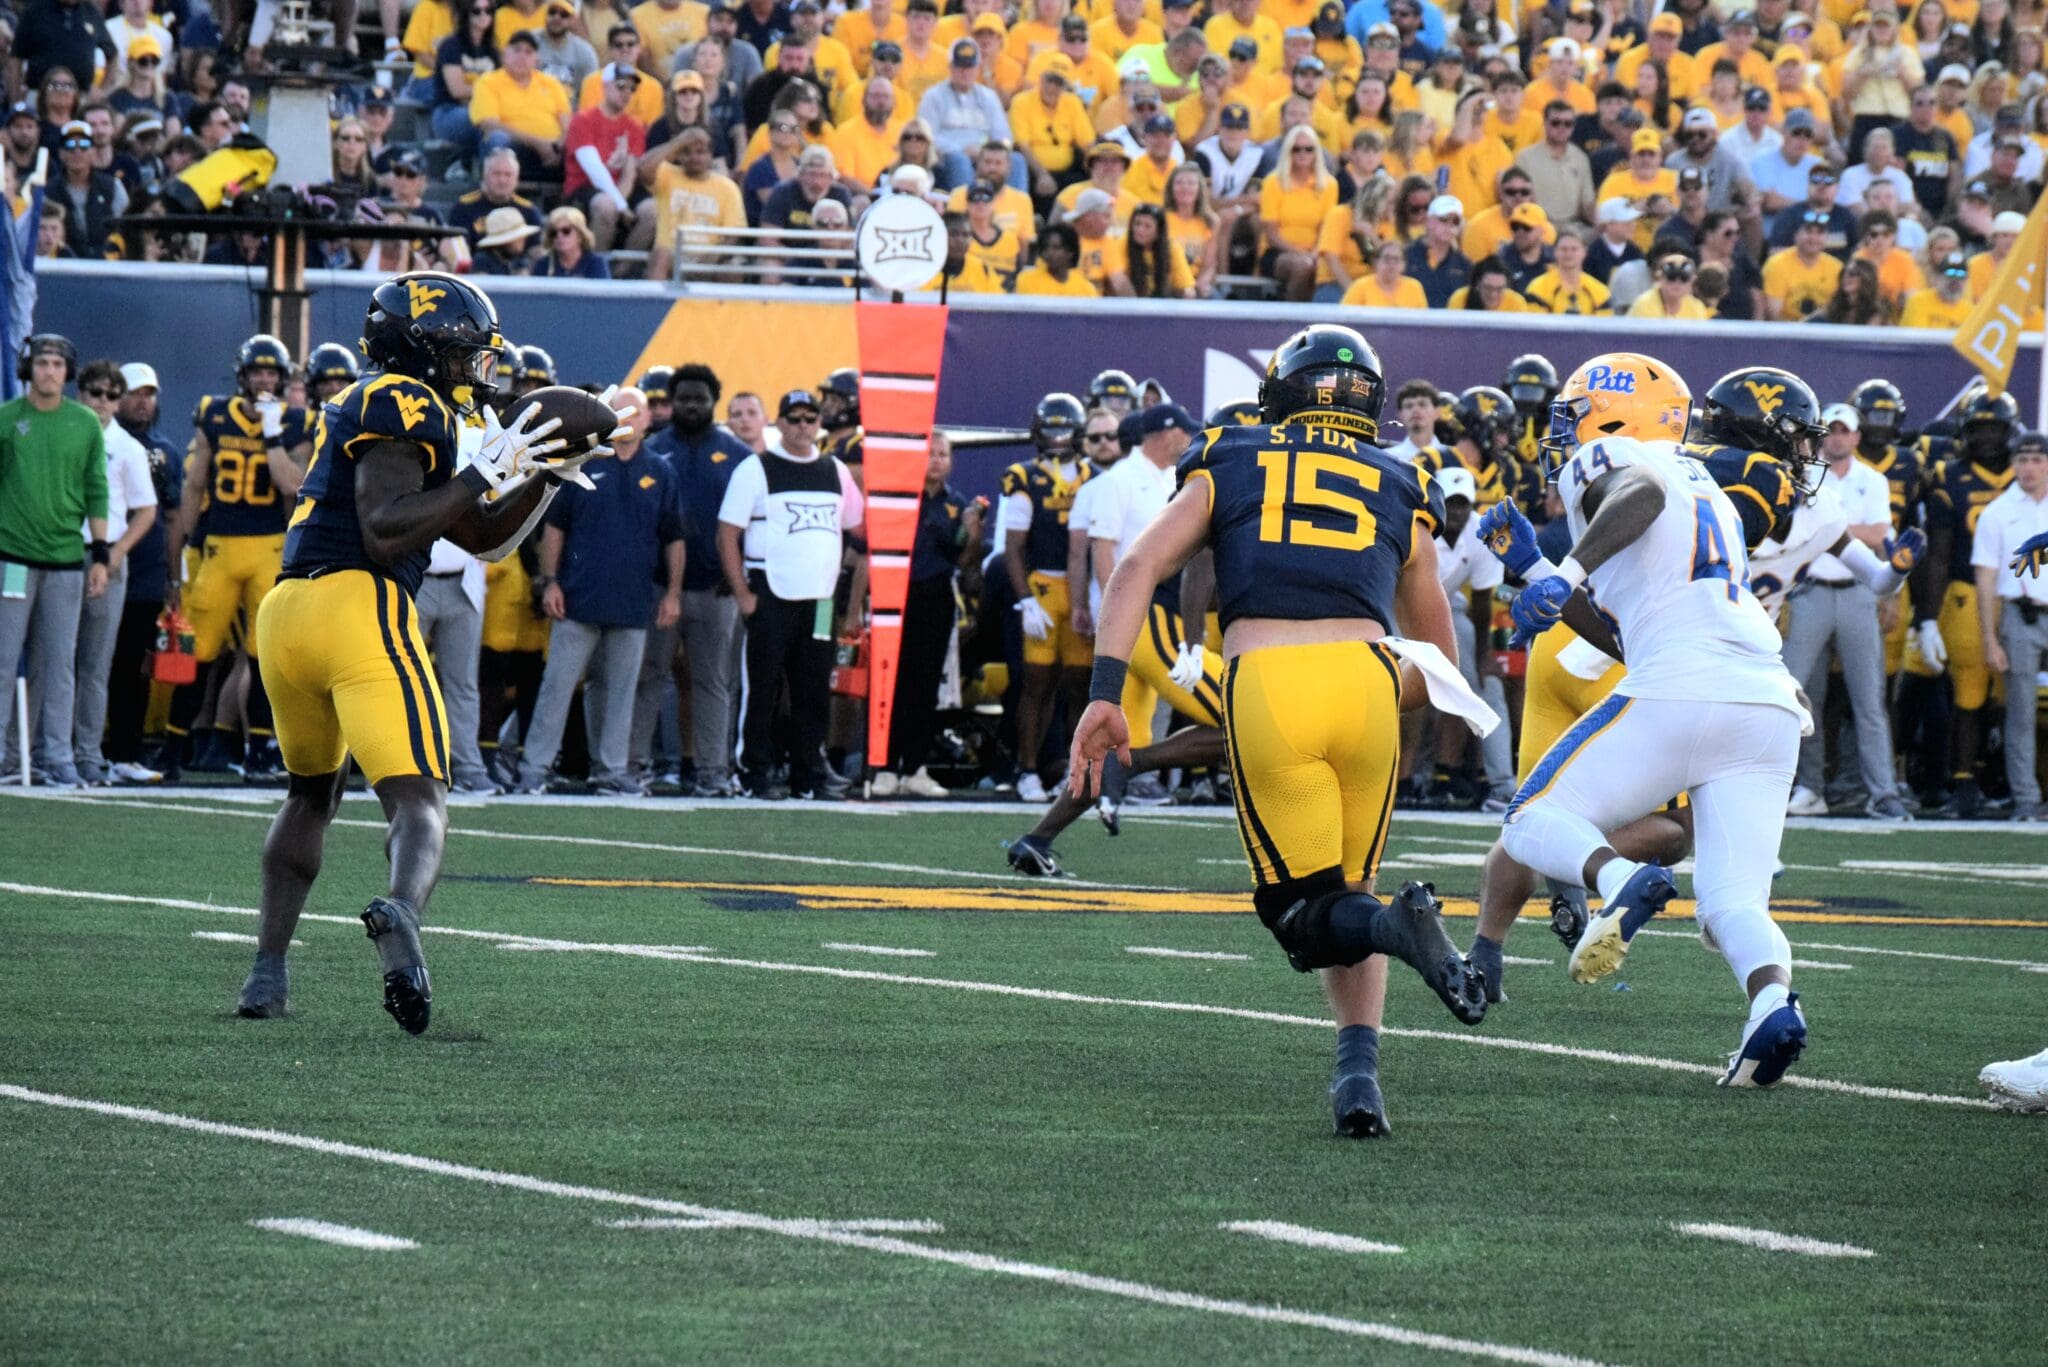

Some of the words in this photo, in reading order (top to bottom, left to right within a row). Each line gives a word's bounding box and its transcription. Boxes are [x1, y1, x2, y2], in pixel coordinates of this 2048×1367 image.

[1317, 388, 1333, 405] 15
[1585, 365, 1637, 394] Pitt
[1269, 424, 1294, 445] S.
[1305, 424, 1358, 454] FOX
[214, 450, 276, 506] 80
[1571, 443, 1613, 487] 44
[1257, 450, 1382, 552] 15
